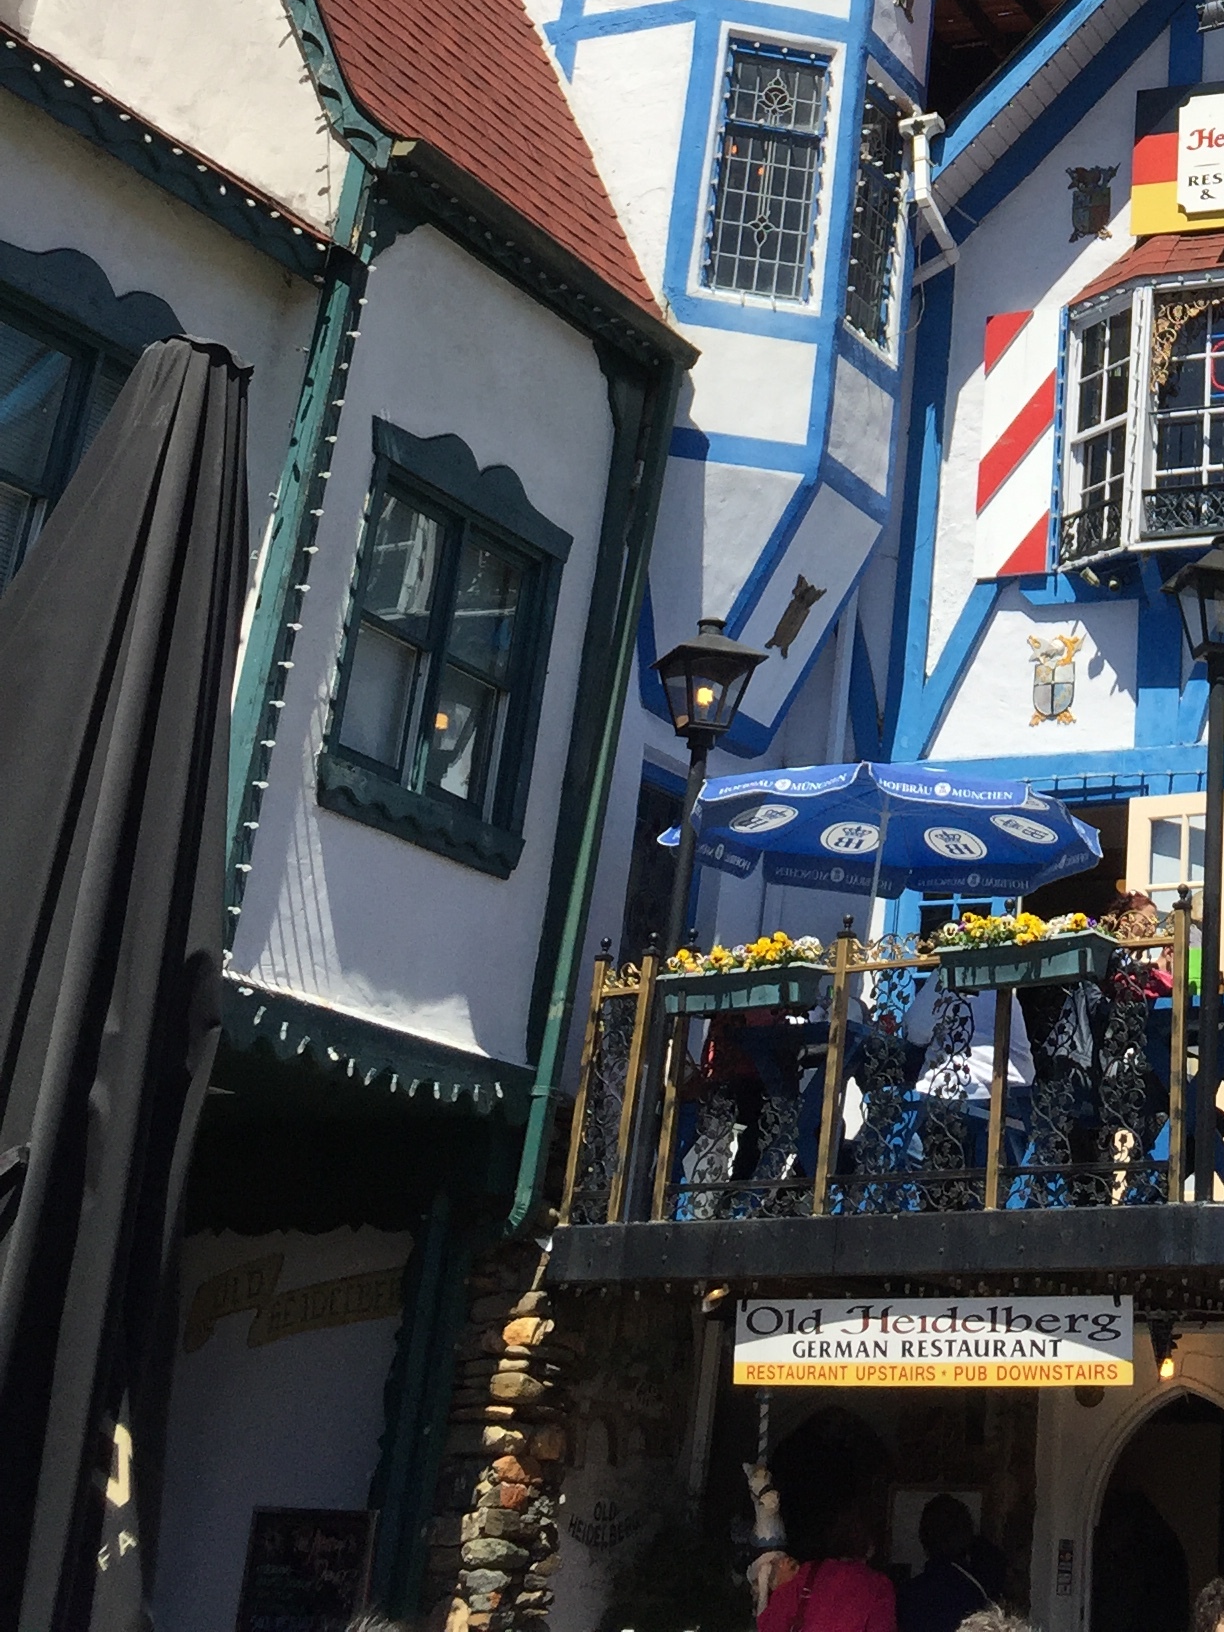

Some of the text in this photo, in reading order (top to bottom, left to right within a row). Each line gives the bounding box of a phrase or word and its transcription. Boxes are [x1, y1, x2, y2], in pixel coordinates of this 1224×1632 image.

[1199, 188, 1217, 201] &
[878, 778, 1014, 800] HOFBRÄU MÜNCHEN
[746, 1304, 1122, 1342] Old Heidelberg
[792, 1338, 1062, 1359] GERMAN RESTAURANT
[746, 1364, 1118, 1381] RESTAURANT UPSTAIRS PUB DOWNSTAIRS
